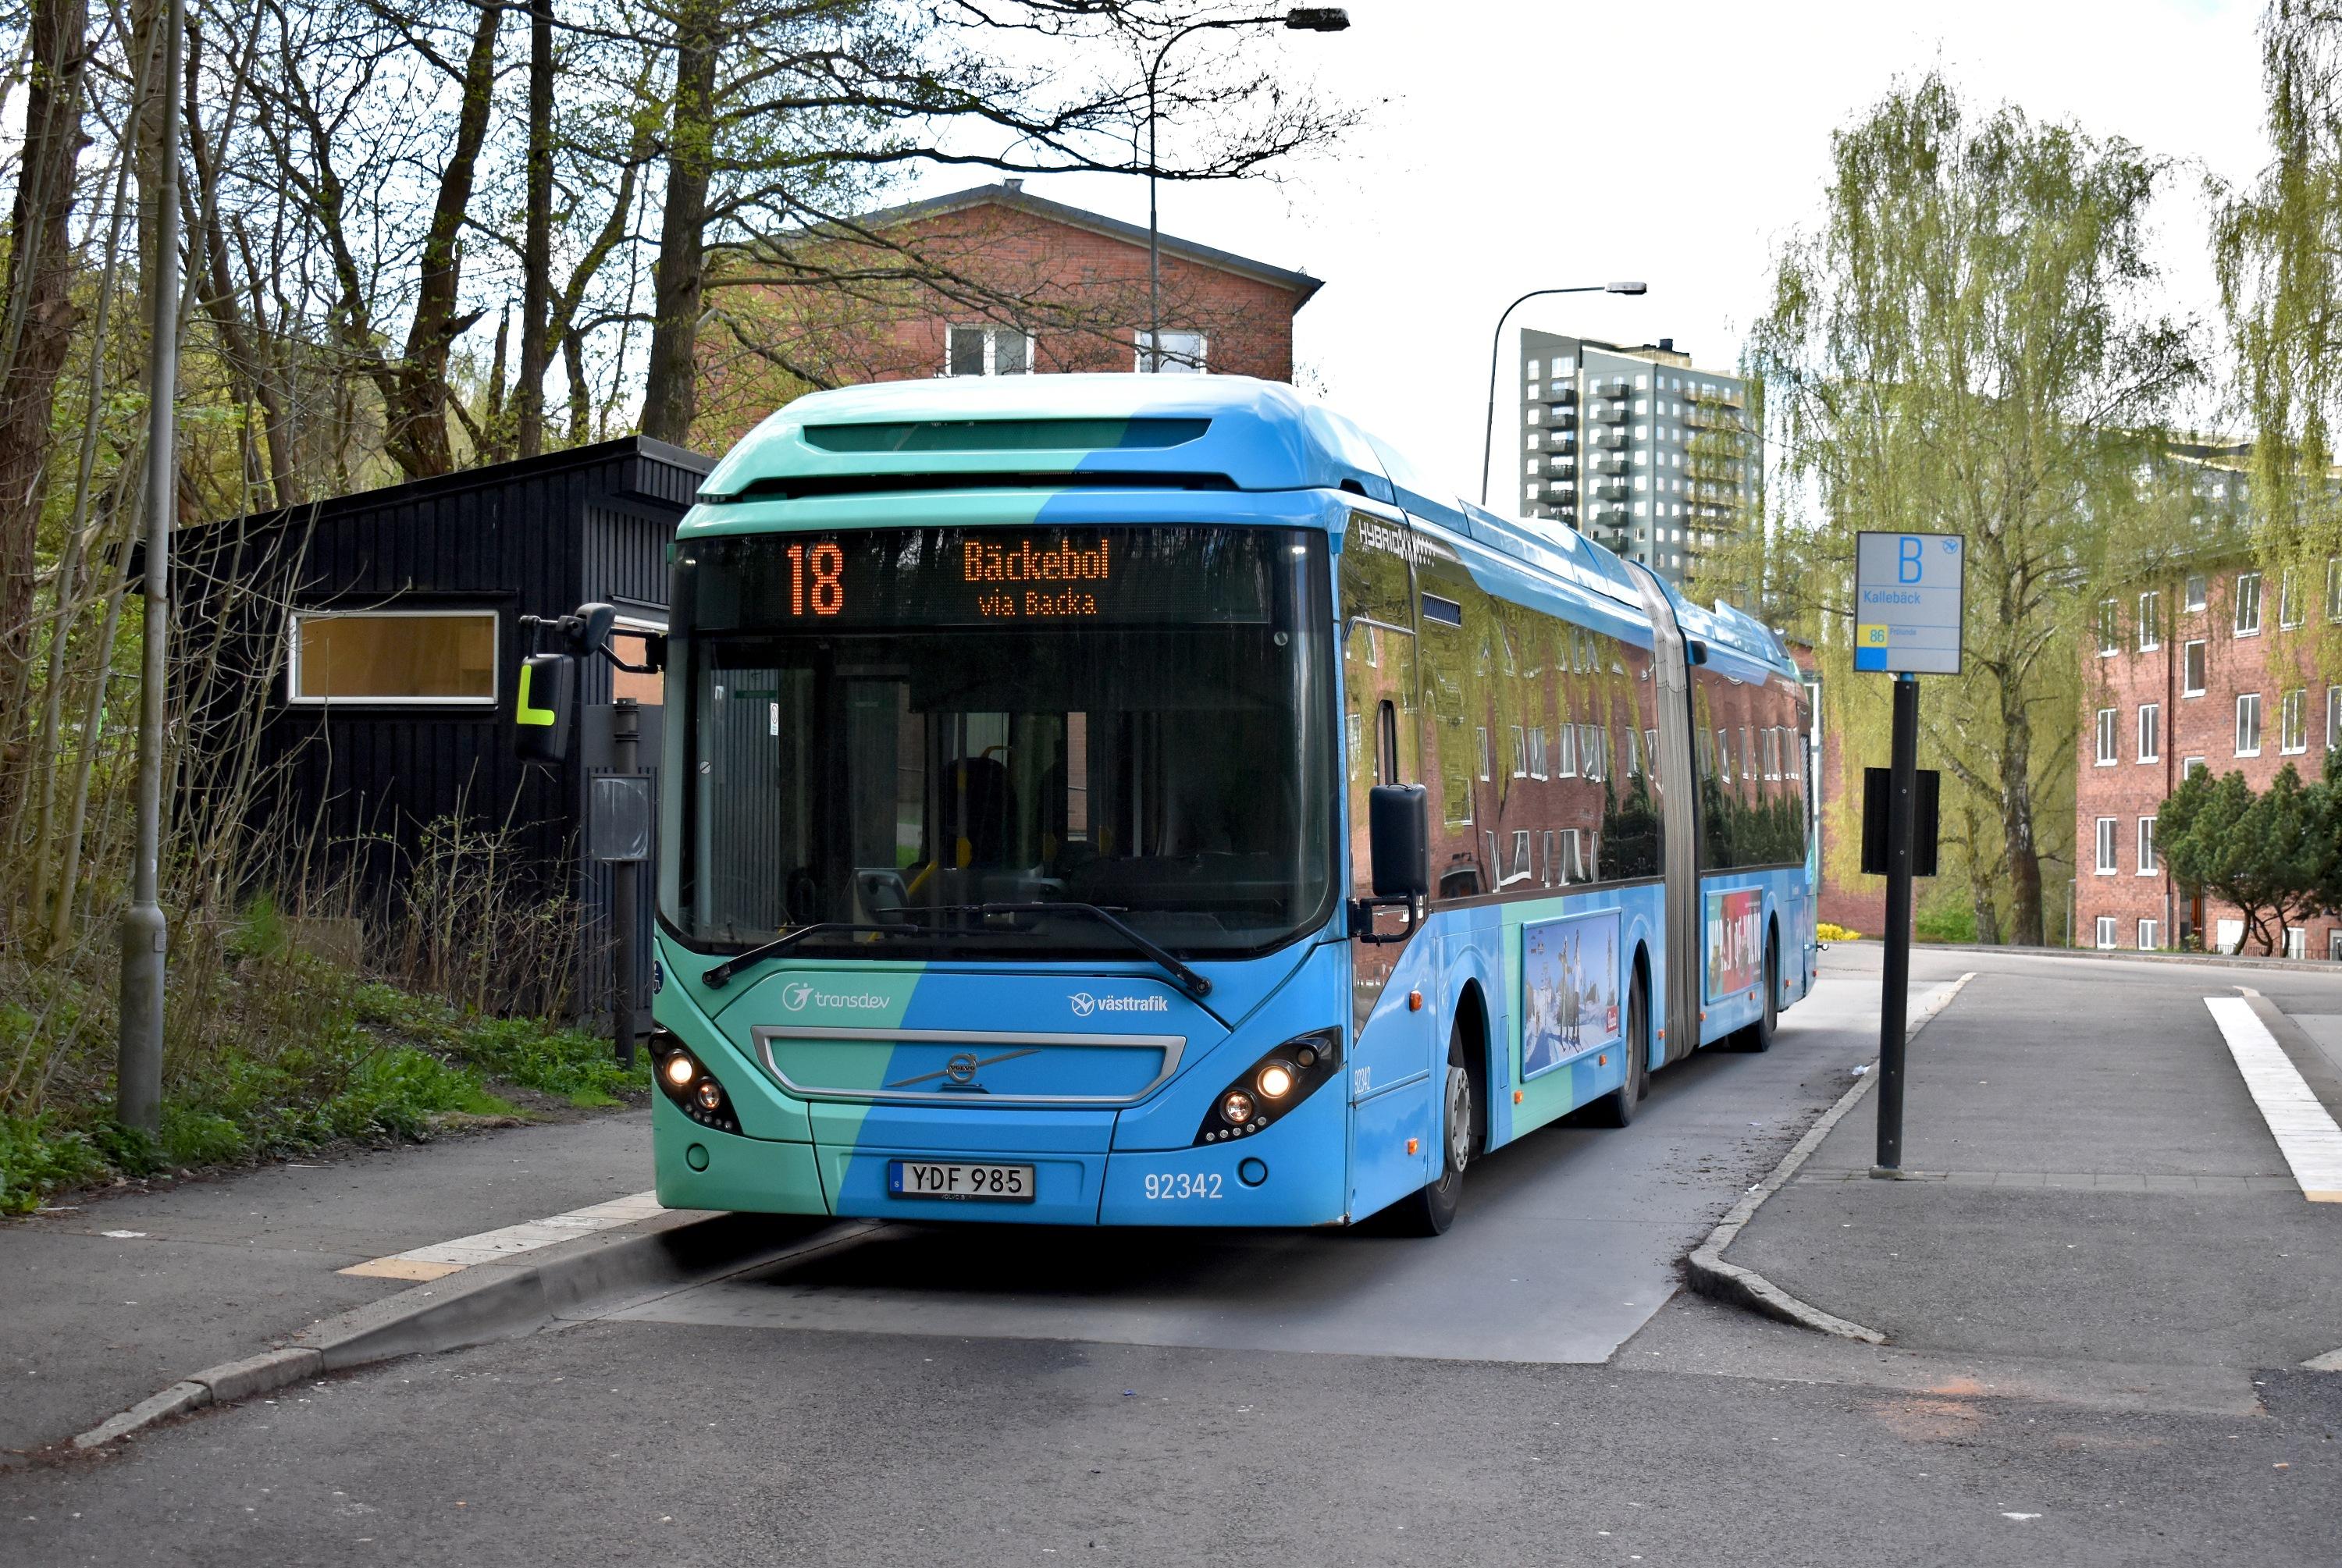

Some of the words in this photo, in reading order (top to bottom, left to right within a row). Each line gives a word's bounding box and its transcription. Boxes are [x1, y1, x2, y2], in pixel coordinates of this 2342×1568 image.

[1358, 519, 1400, 554] HYBRID
[965, 539, 1109, 581] Bäckebol
[1898, 536, 1923, 584] B
[787, 544, 843, 615] 18
[979, 588, 1016, 615] via
[1026, 587, 1097, 615] Backa
[1863, 590, 1920, 605] Kallebäck
[1870, 629, 1885, 642] 86
[814, 991, 890, 1008] transdev
[1098, 995, 1168, 1012] västtrafik
[1354, 1065, 1371, 1094] 92342
[913, 1166, 961, 1190] YDF
[971, 1168, 1022, 1193] 985
[1144, 1173, 1223, 1199] 92342
